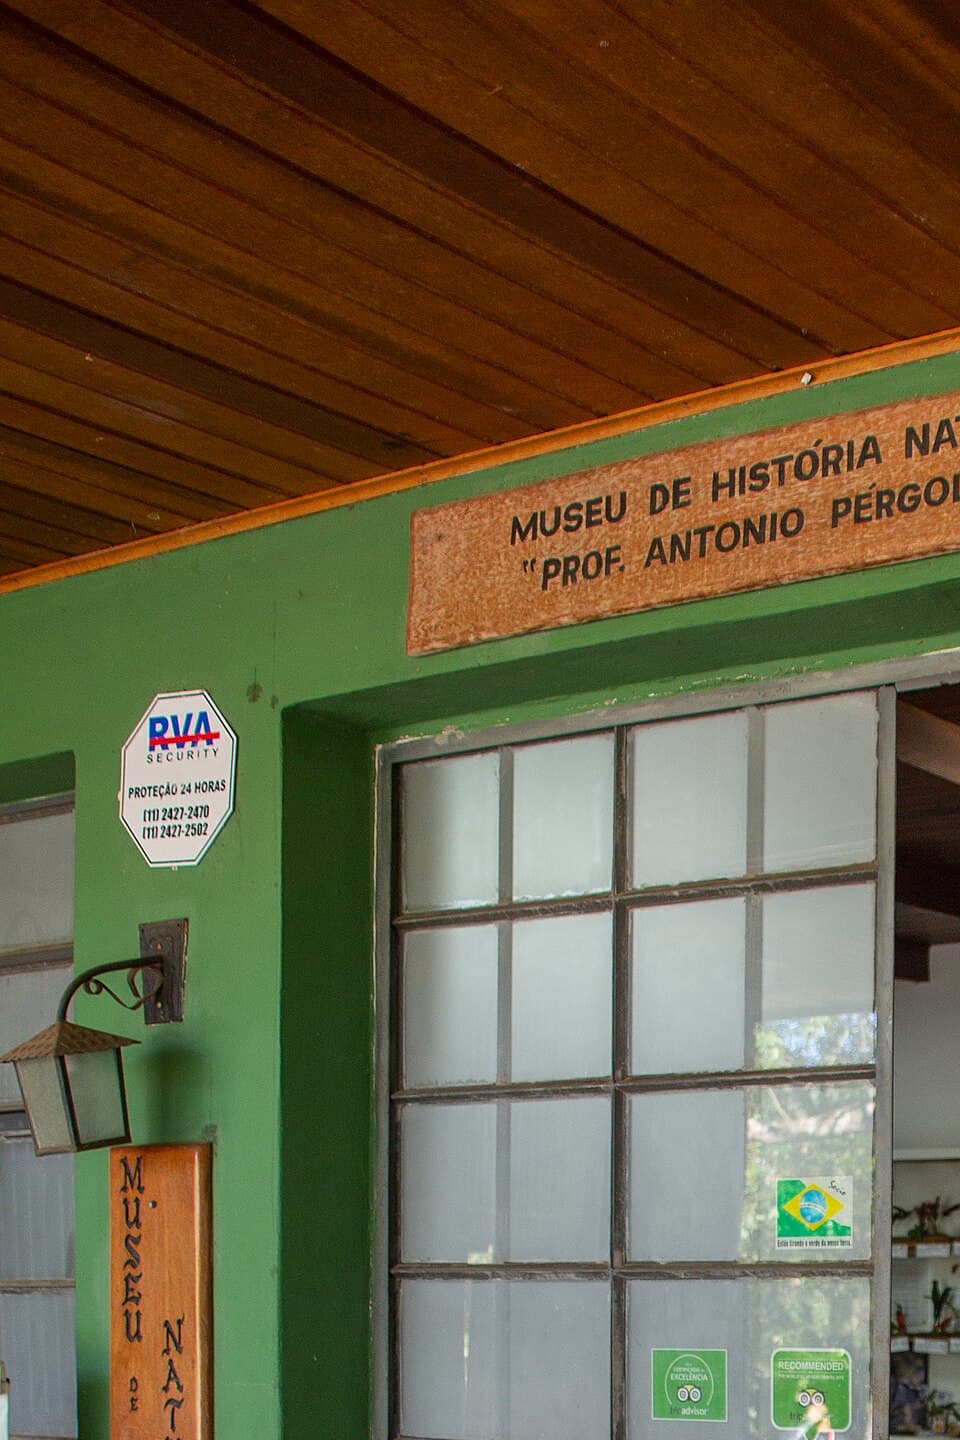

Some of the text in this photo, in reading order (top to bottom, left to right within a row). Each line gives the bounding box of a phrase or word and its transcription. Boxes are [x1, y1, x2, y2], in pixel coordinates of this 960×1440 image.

[510, 490, 627, 546] MUSEU
[649, 476, 692, 516] DE
[711, 434, 883, 502] HISTÓRIA
[644, 507, 805, 569] ANTONIO
[148, 711, 214, 752] RVA
[146, 747, 220, 764] SECURITY
[128, 779, 226, 799] PROTEÇÃO 24 HORAS
[143, 804, 210, 822] (11) 2427-2470
[142, 822, 209, 840] (11) 2427-2502
[119, 1155, 145, 1343] MUSEU
[778, 1361, 844, 1371] RECOMMENDED
[128, 1375, 139, 1413] DE
